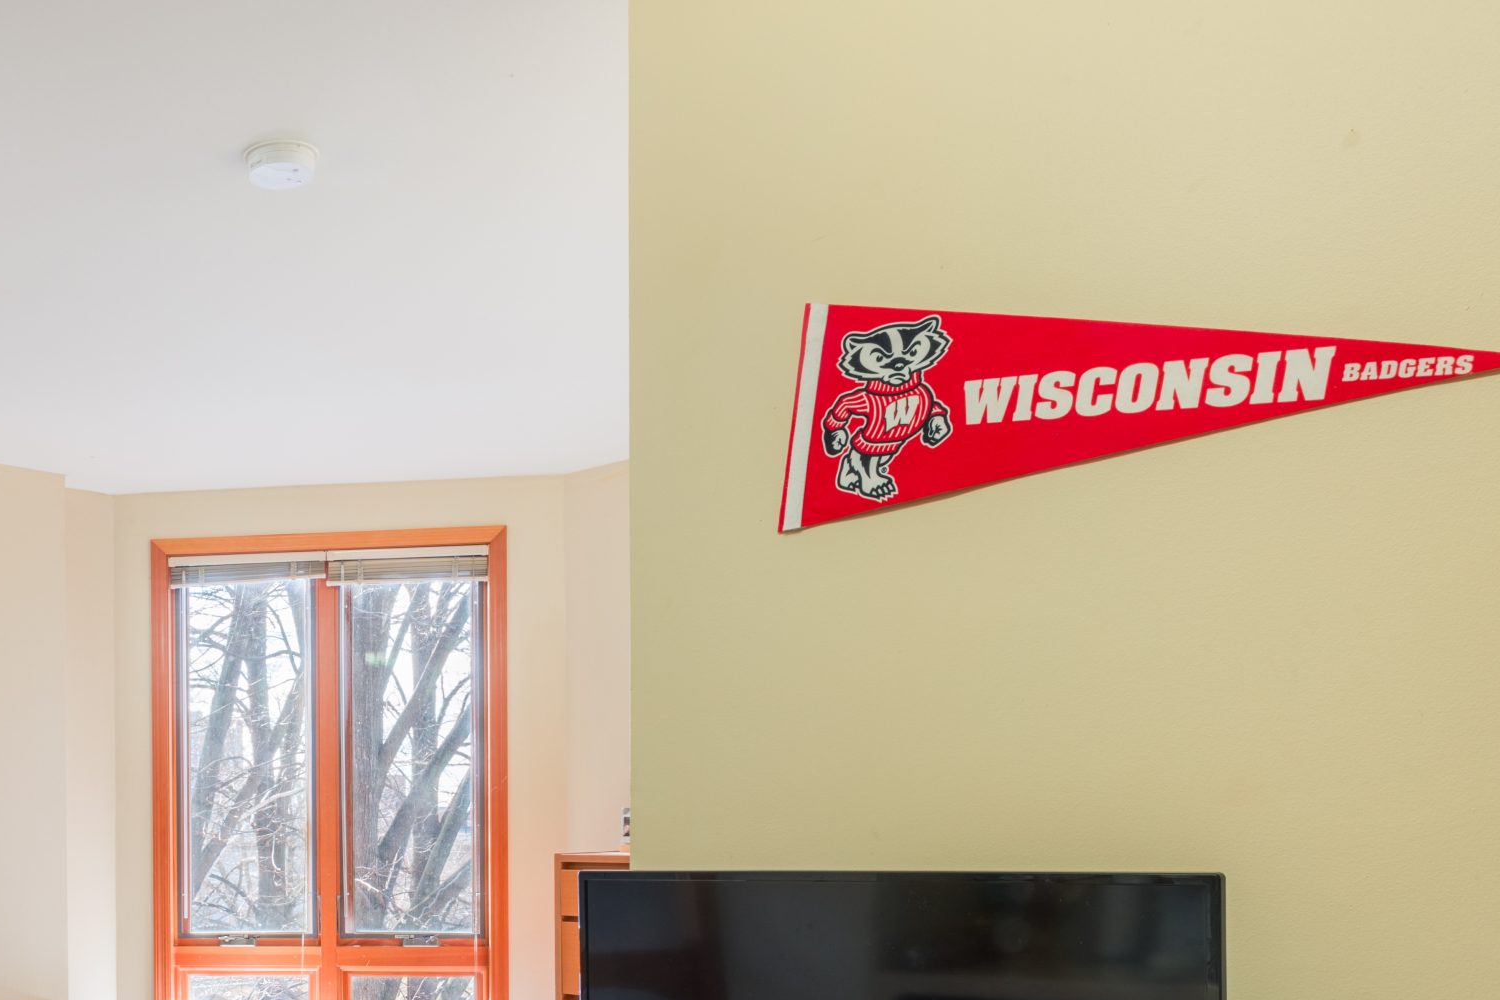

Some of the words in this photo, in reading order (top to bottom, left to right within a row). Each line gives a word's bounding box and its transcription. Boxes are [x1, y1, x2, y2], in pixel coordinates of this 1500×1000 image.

[884, 394, 920, 433] W
[963, 345, 1337, 426] WISCONSIN
[1341, 354, 1474, 383] BADGERS
